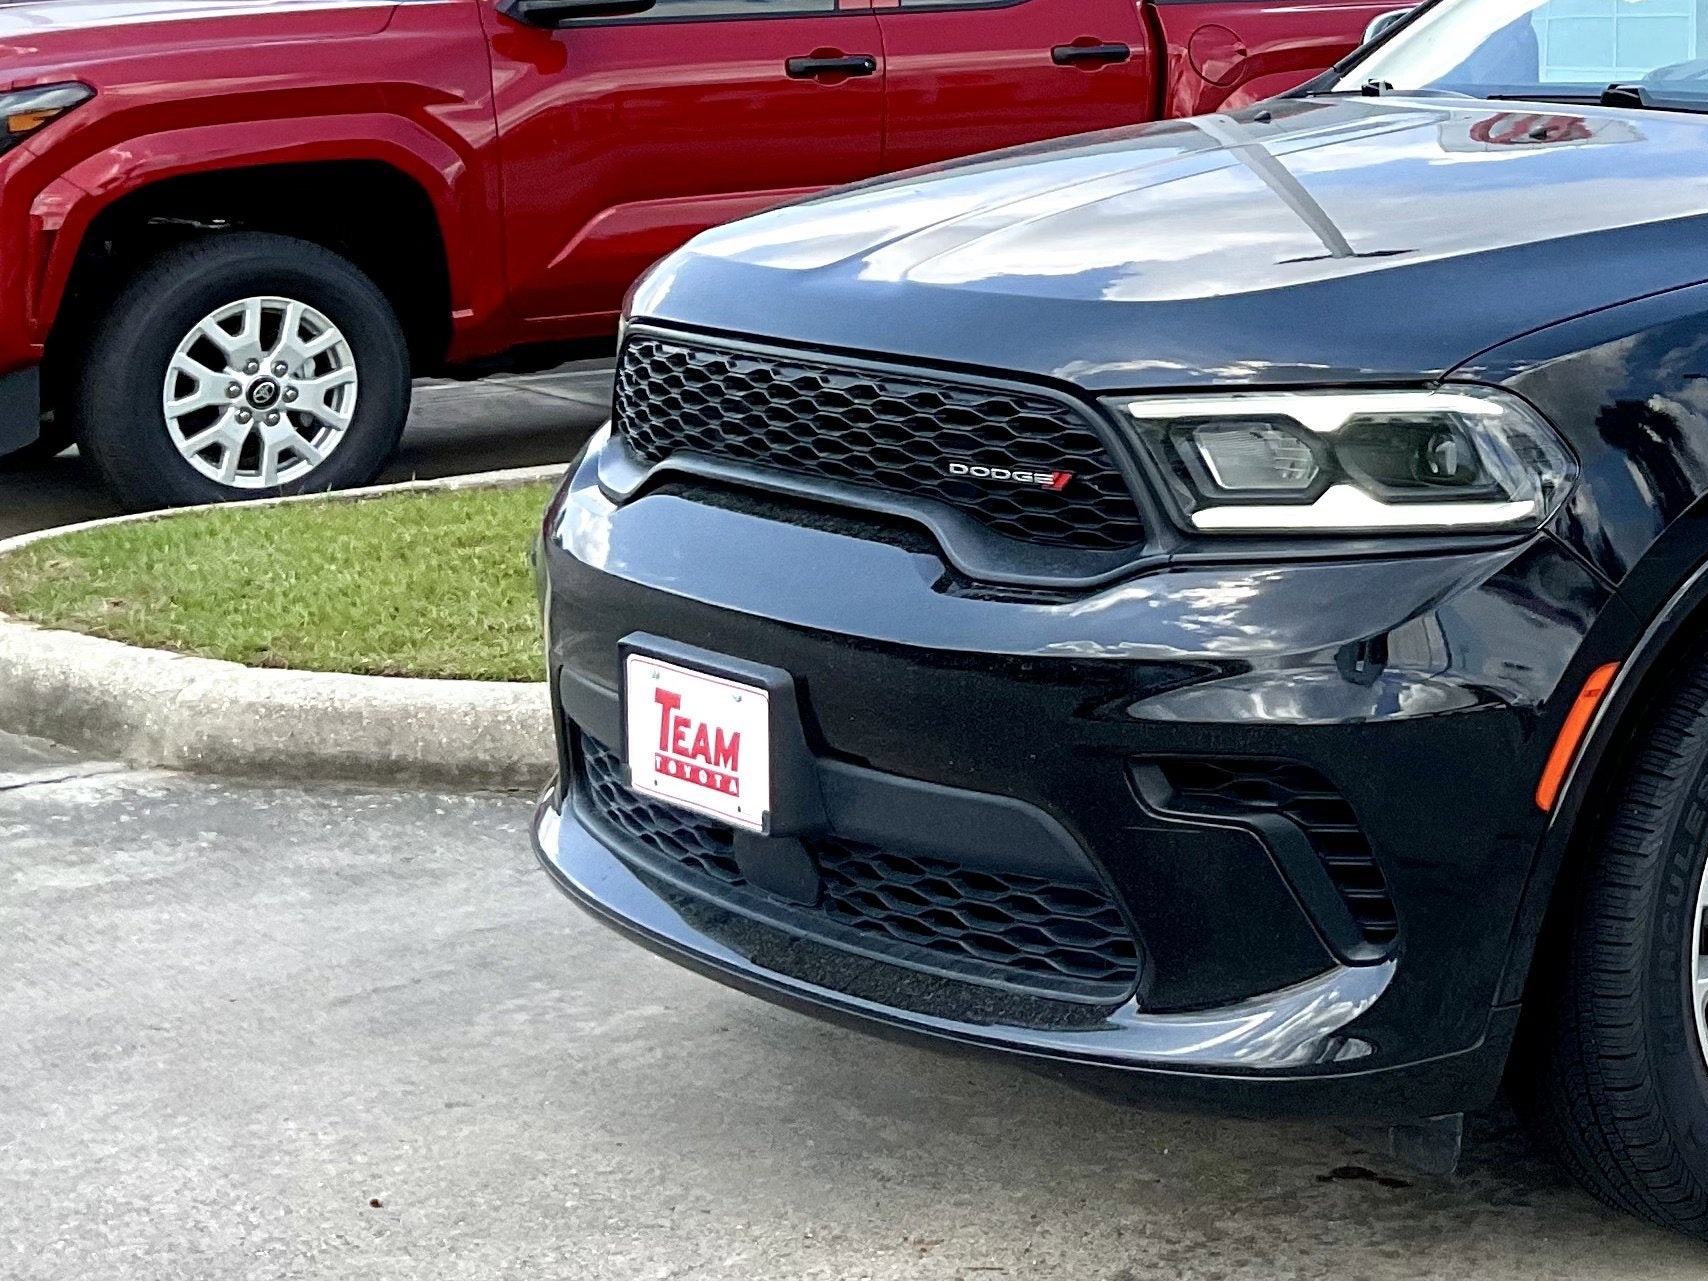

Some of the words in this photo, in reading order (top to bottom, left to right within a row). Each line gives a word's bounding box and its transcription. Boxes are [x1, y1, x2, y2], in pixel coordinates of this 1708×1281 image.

[949, 463, 1054, 485] DODGE
[655, 687, 741, 772] TEAM
[655, 755, 738, 793] TOYOTA
